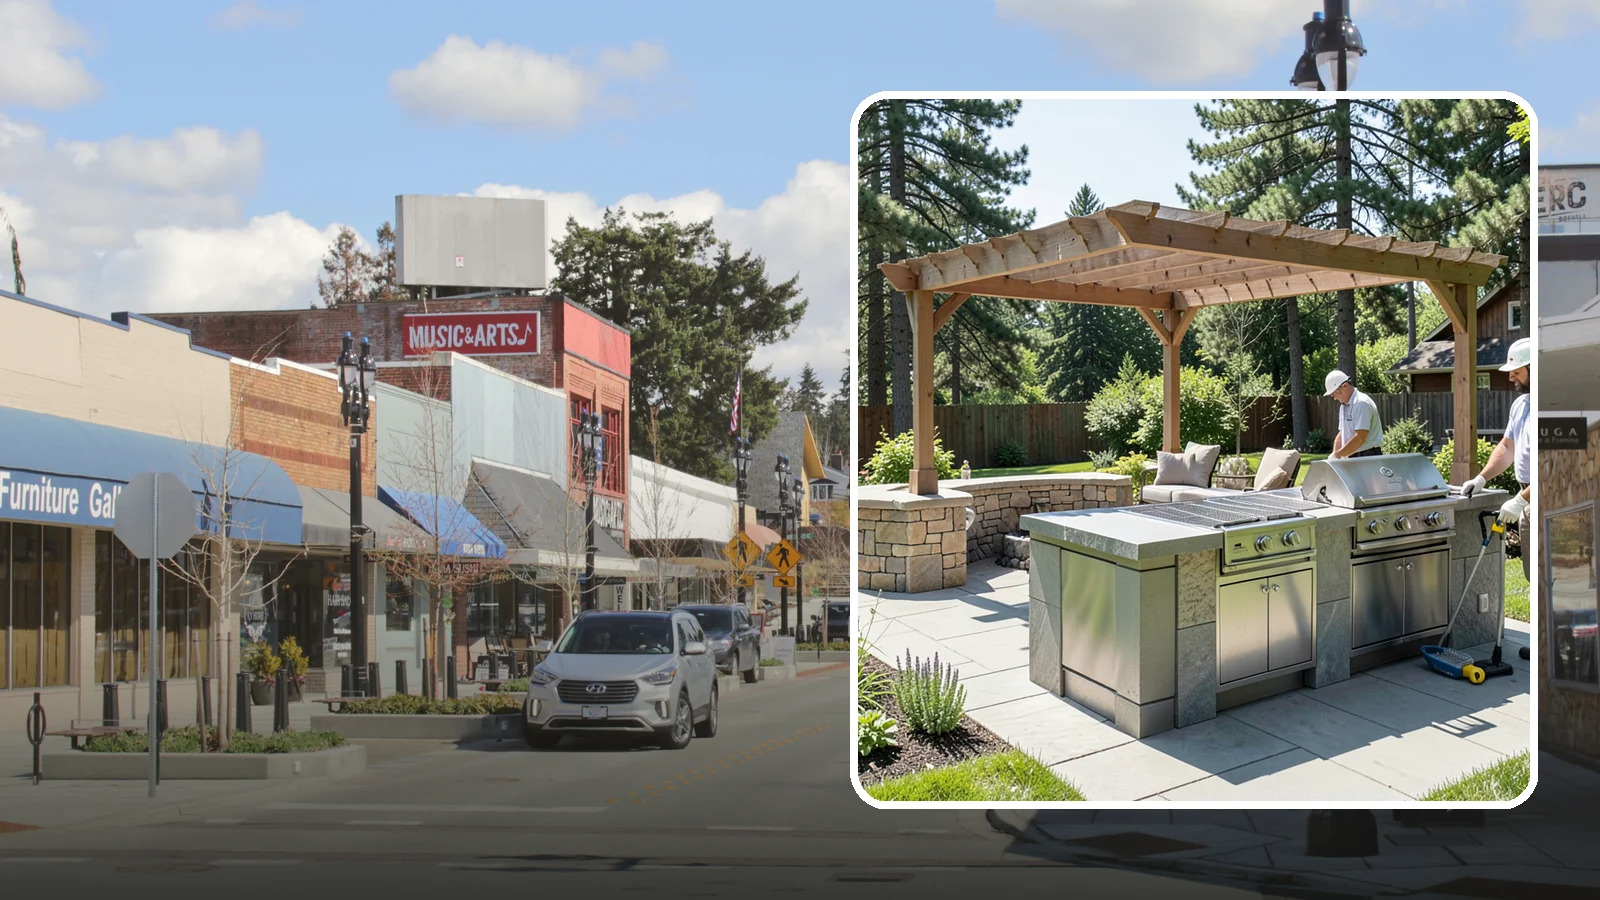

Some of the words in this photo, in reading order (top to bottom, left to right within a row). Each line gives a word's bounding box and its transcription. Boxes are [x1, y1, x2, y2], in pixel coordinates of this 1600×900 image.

[0, 471, 79, 516] Furniture
[89, 482, 121, 519] Gal
[453, 563, 479, 574] SUSHI
